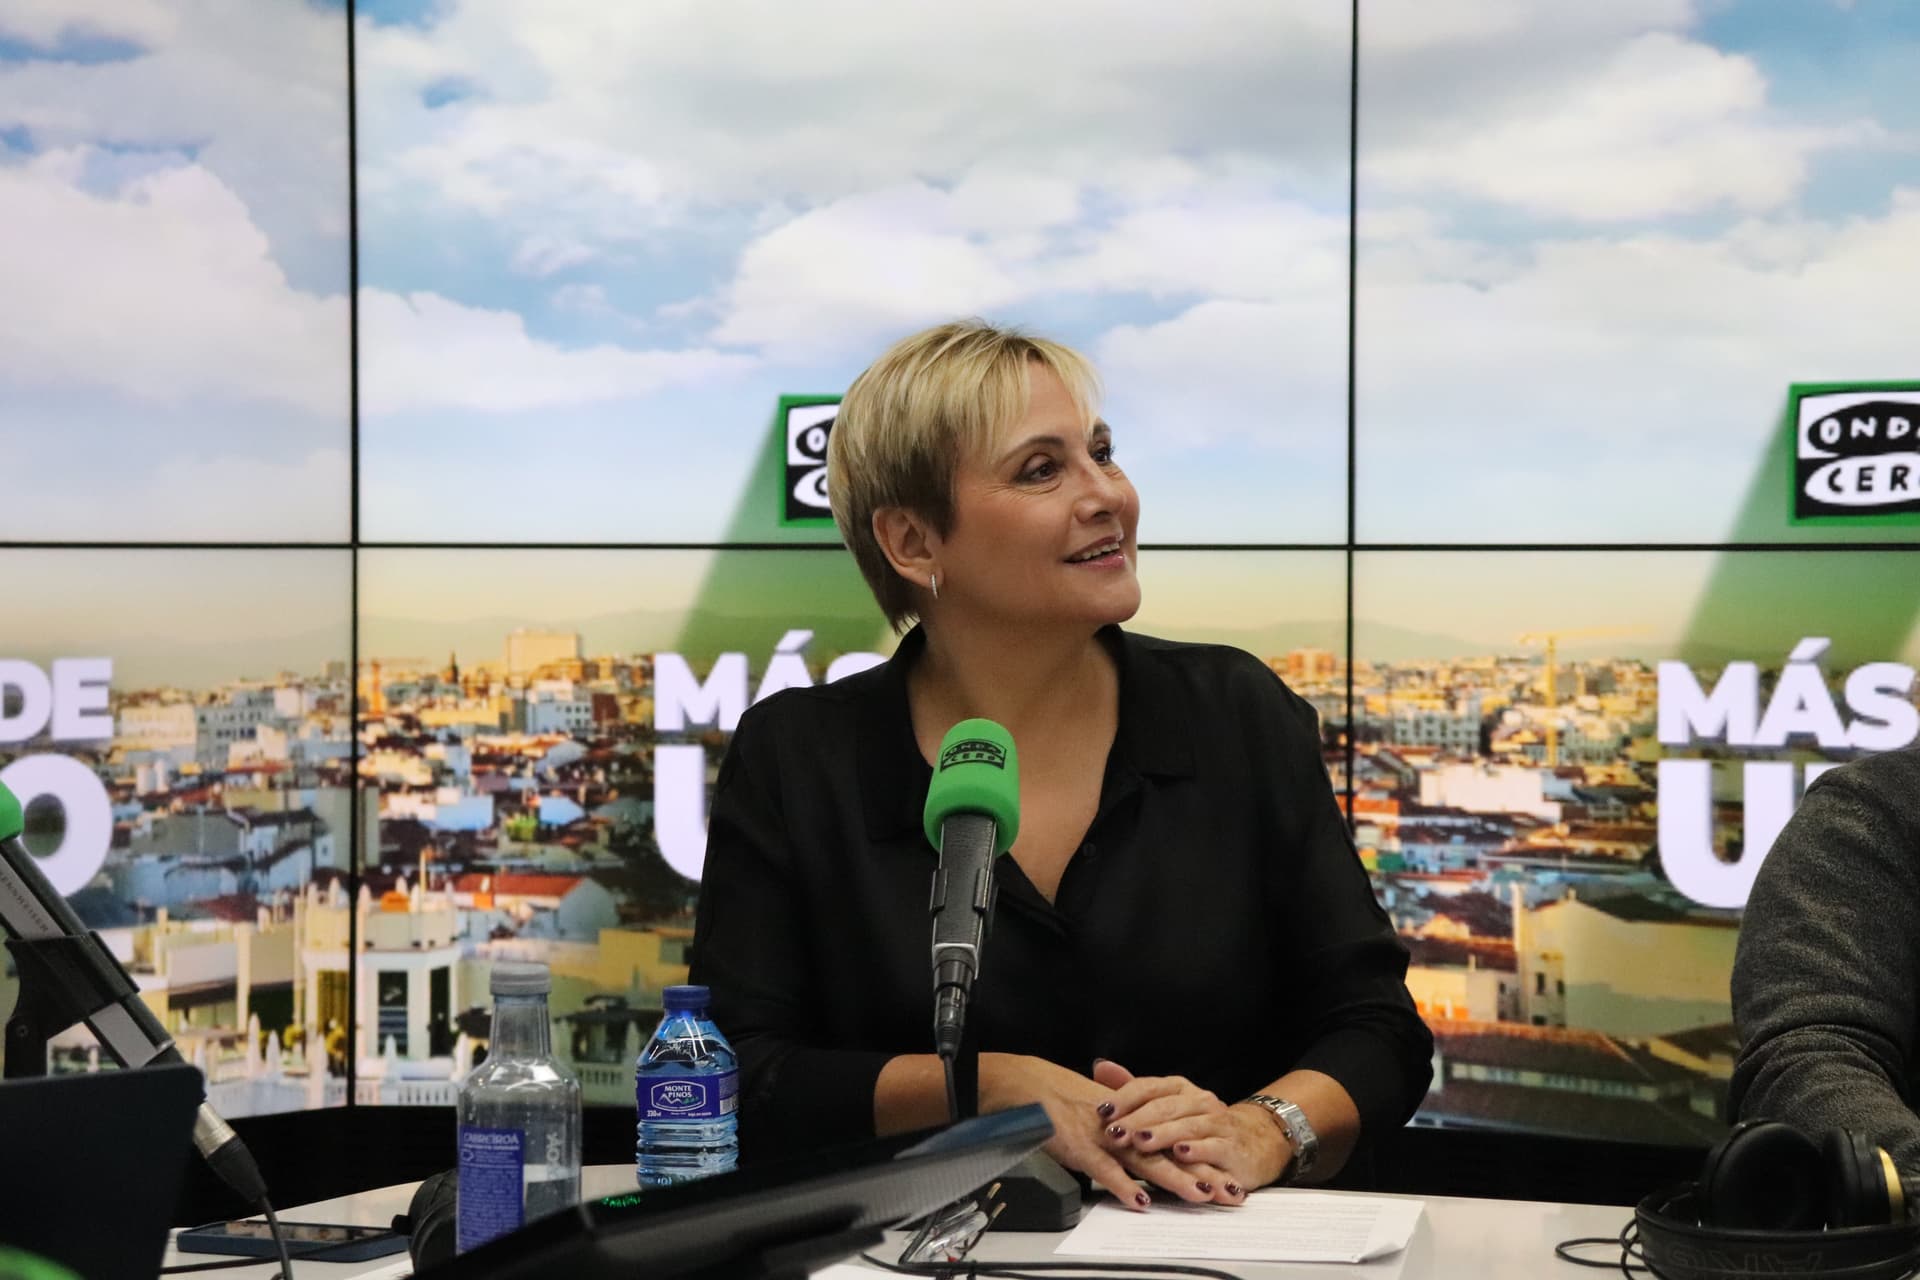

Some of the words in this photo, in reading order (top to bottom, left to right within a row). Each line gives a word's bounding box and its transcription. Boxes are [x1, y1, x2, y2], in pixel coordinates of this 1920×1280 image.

[1820, 417, 1920, 444] OND
[1828, 466, 1920, 493] CER
[653, 629, 889, 732] MÁ
[1657, 637, 1920, 750] MÁS
[1657, 759, 1848, 909] U
